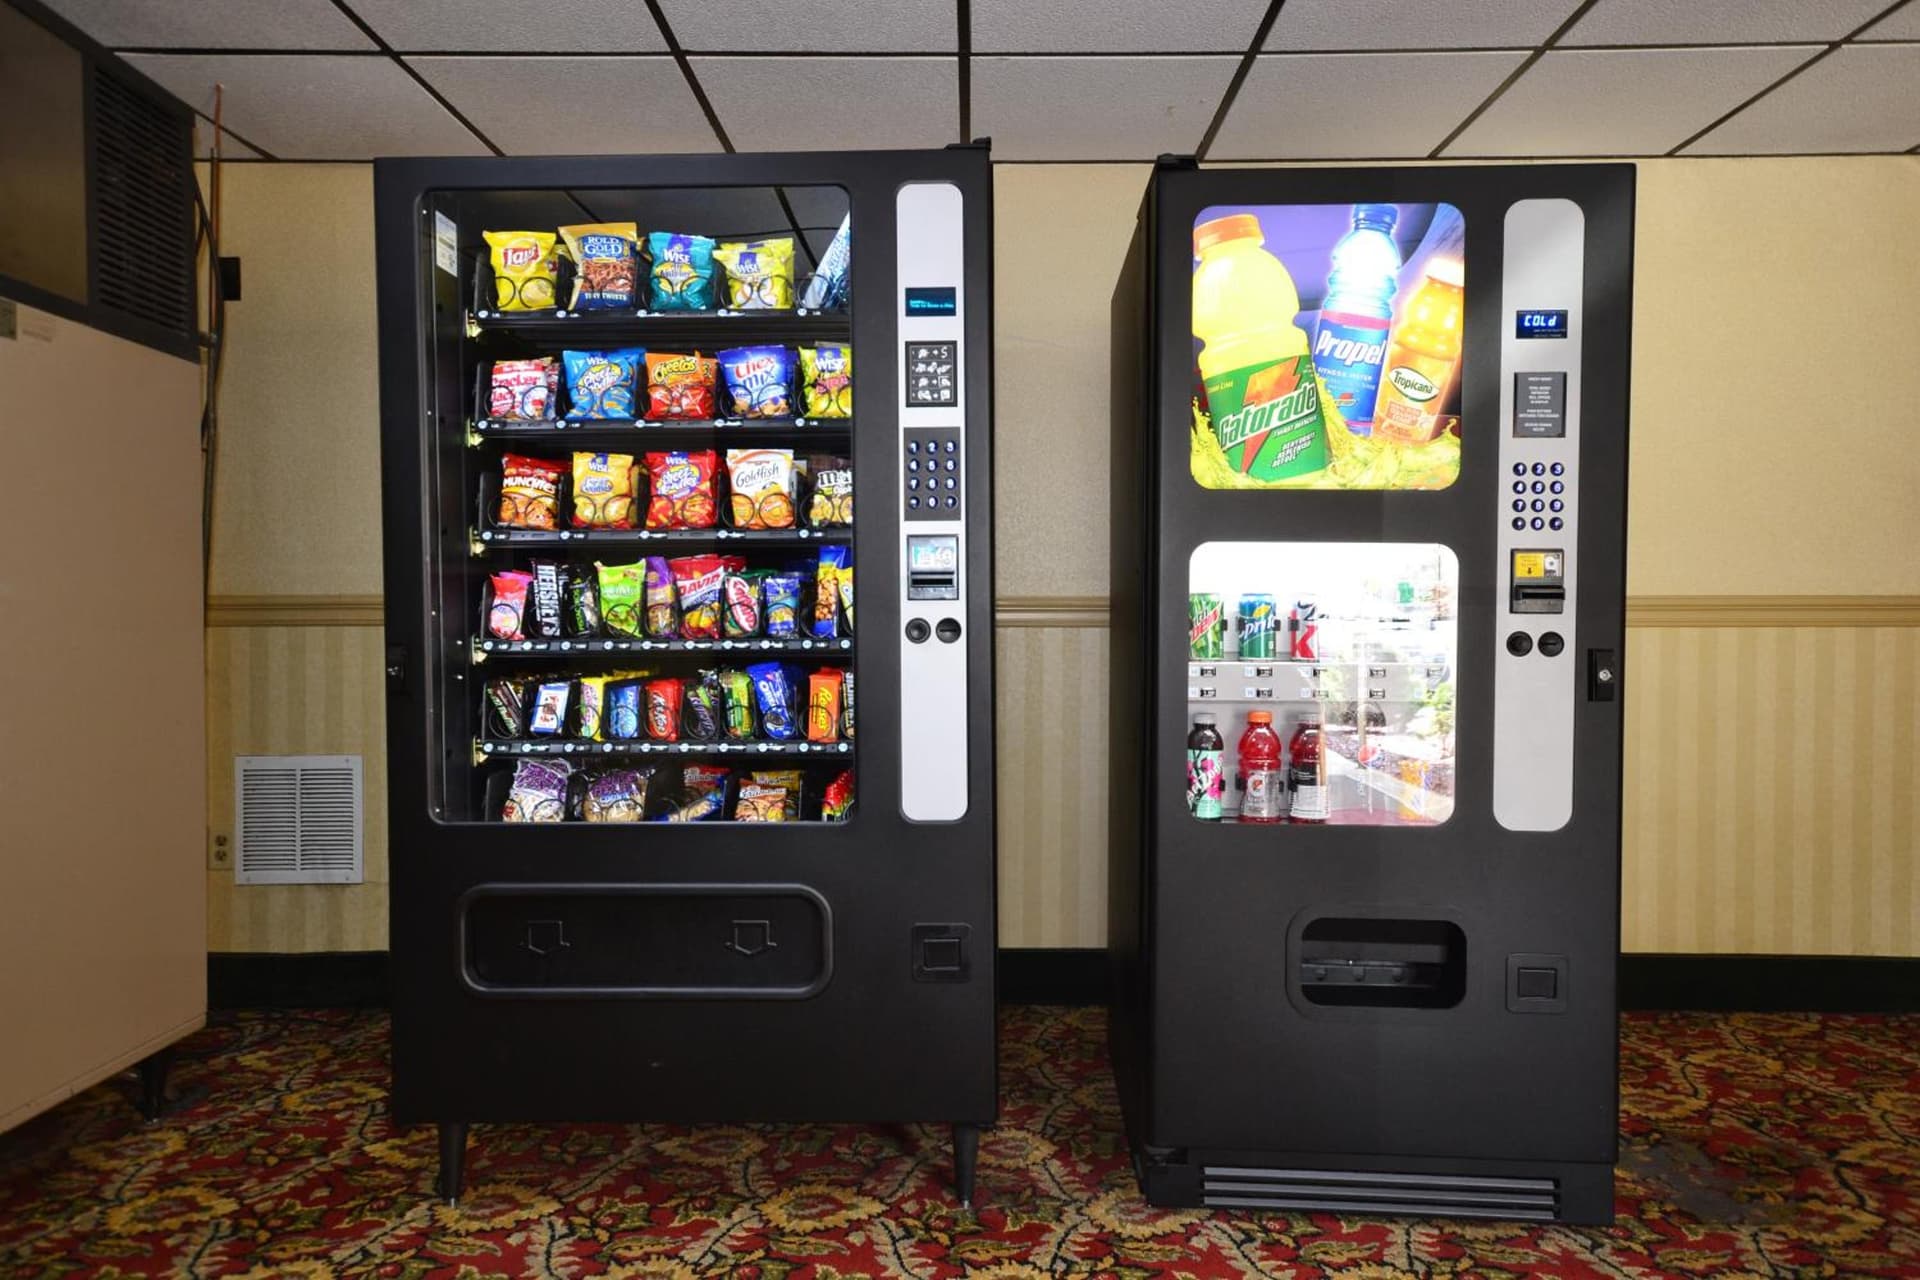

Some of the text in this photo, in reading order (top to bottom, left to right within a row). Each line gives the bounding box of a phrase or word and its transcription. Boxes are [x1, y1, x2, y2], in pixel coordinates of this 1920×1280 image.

[585, 244, 622, 255] GOLD
[1315, 329, 1387, 367] Propel
[654, 356, 697, 383] Cheetos
[735, 355, 775, 380] Chex
[1393, 369, 1433, 394] Tropicana
[1220, 382, 1317, 449] Gatorade
[911, 442, 917, 452] 1
[929, 442, 936, 452] 2
[735, 463, 780, 488] Goldfish
[911, 460, 917, 470] 4
[947, 460, 954, 470] 6
[1517, 465, 1562, 475] 1 2 3
[1517, 483, 1524, 493] 4
[1517, 500, 1562, 511] 7 8 9
[537, 564, 561, 636] HERSHEY'S
